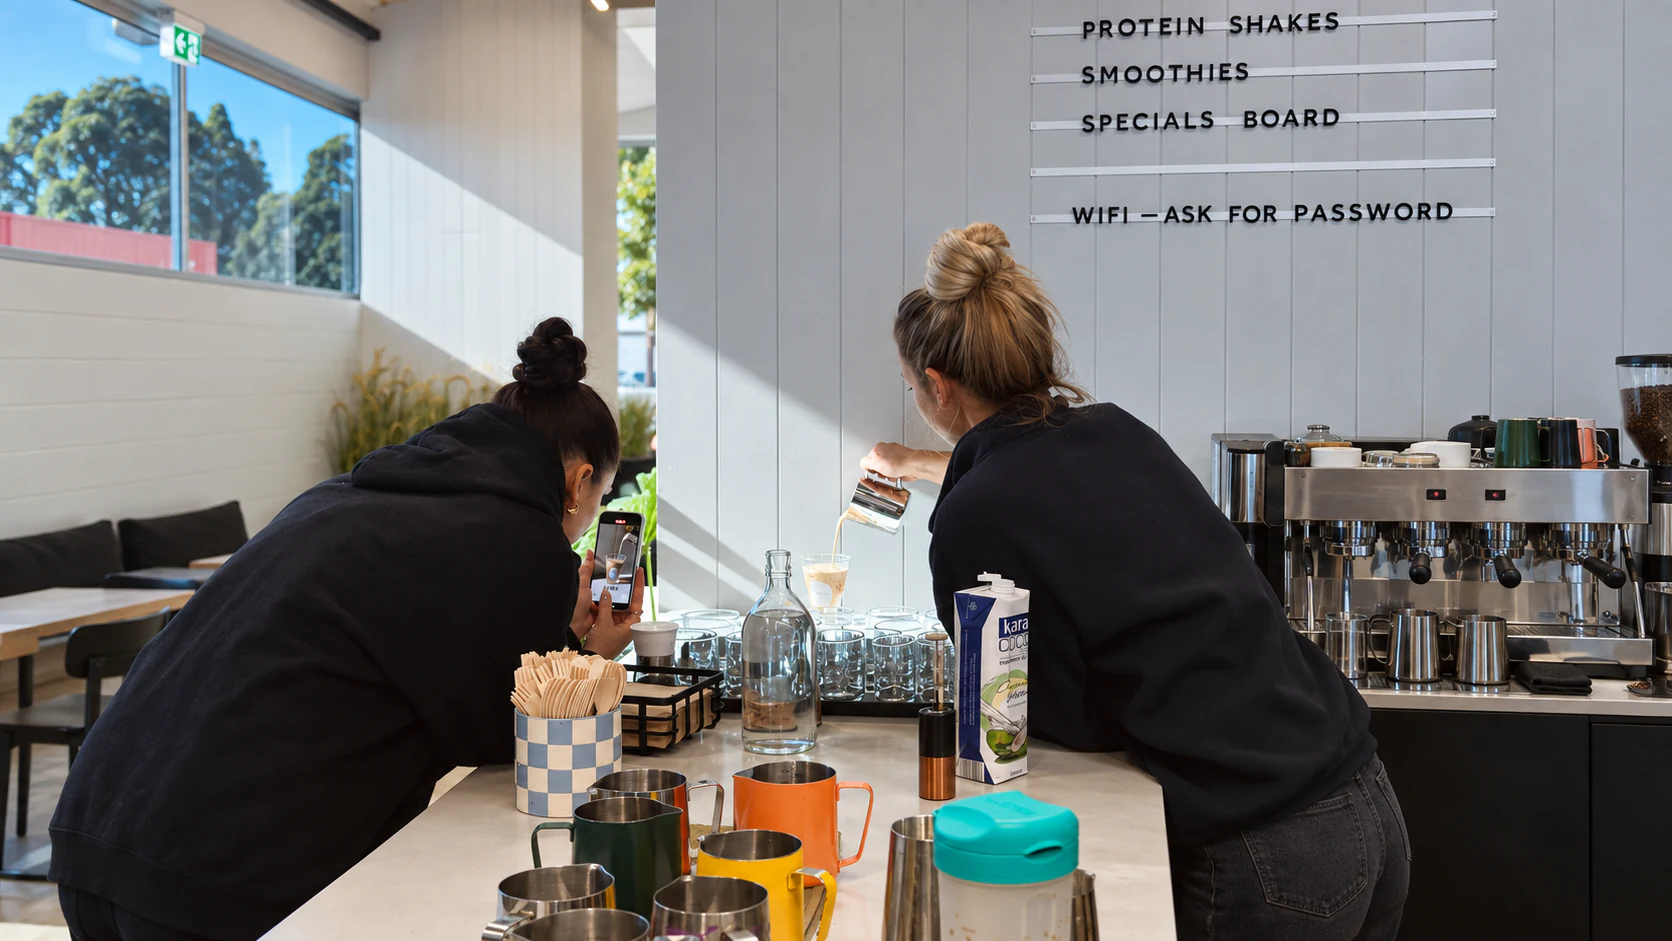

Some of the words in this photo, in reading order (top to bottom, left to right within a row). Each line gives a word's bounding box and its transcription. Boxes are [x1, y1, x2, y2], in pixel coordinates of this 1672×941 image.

[1082, 16, 1205, 40] PROTEIN
[1229, 11, 1340, 35] SHAKES
[1081, 62, 1249, 85] SMOOTHIES
[1081, 110, 1214, 134] SPECIALS
[1243, 108, 1340, 129] BOARD
[1071, 206, 1128, 225] WIFI
[1229, 204, 1277, 224] FOR
[1294, 202, 1454, 223] PASSWORD
[1003, 617, 1028, 636] kara
